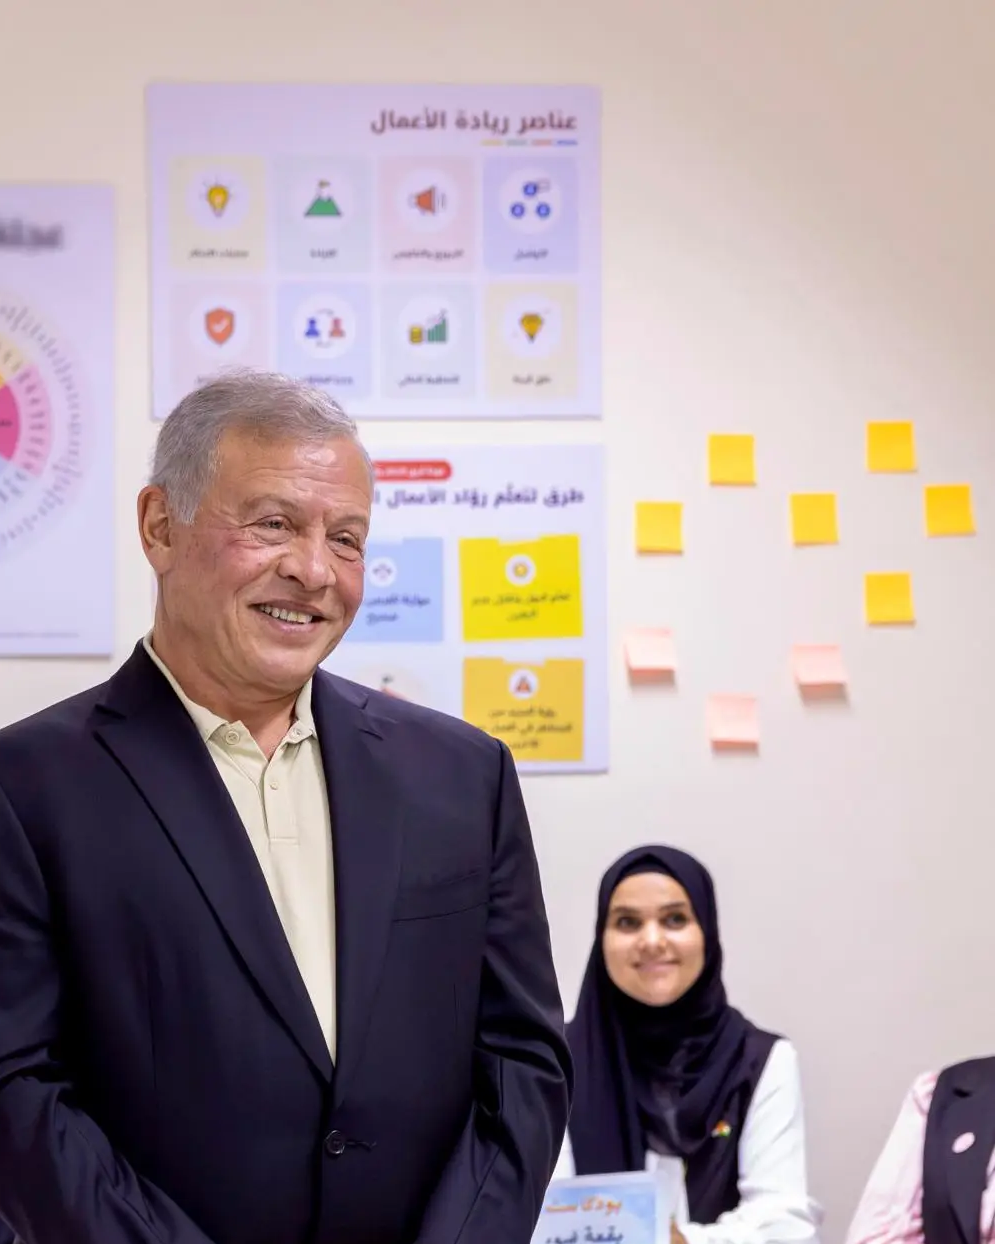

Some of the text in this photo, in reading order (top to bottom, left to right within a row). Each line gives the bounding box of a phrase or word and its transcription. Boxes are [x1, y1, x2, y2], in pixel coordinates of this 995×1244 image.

[370, 103, 578, 135] عناصر ريادة الأعمال
